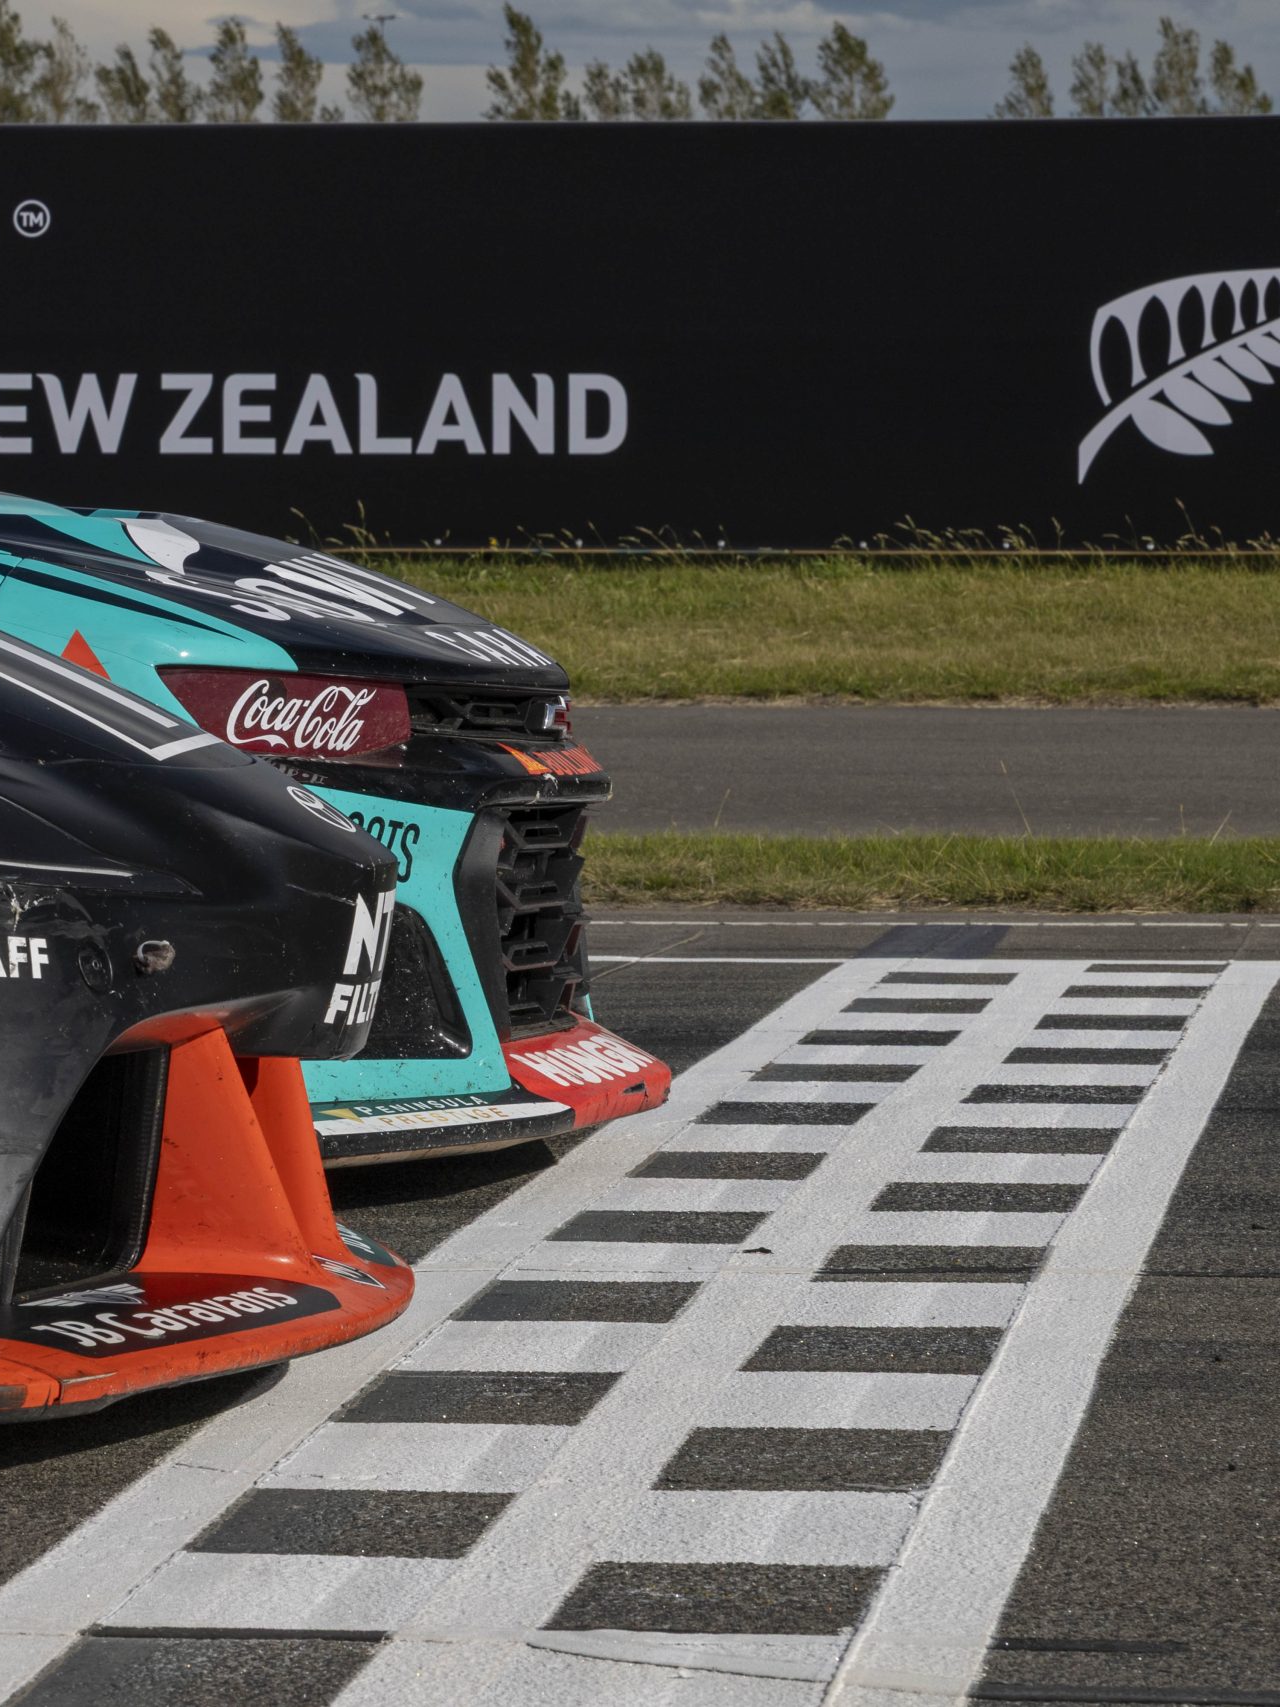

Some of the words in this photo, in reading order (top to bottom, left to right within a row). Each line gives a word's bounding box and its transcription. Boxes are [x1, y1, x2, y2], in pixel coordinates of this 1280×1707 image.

[159, 373, 628, 455] ZEALAND
[226, 679, 377, 752] Coca-Cola
[353, 1095, 489, 1116] PENINSULA
[378, 1107, 510, 1127] PRESTIGE
[30, 1320, 126, 1347] JB
[95, 1286, 299, 1337] Caravans
